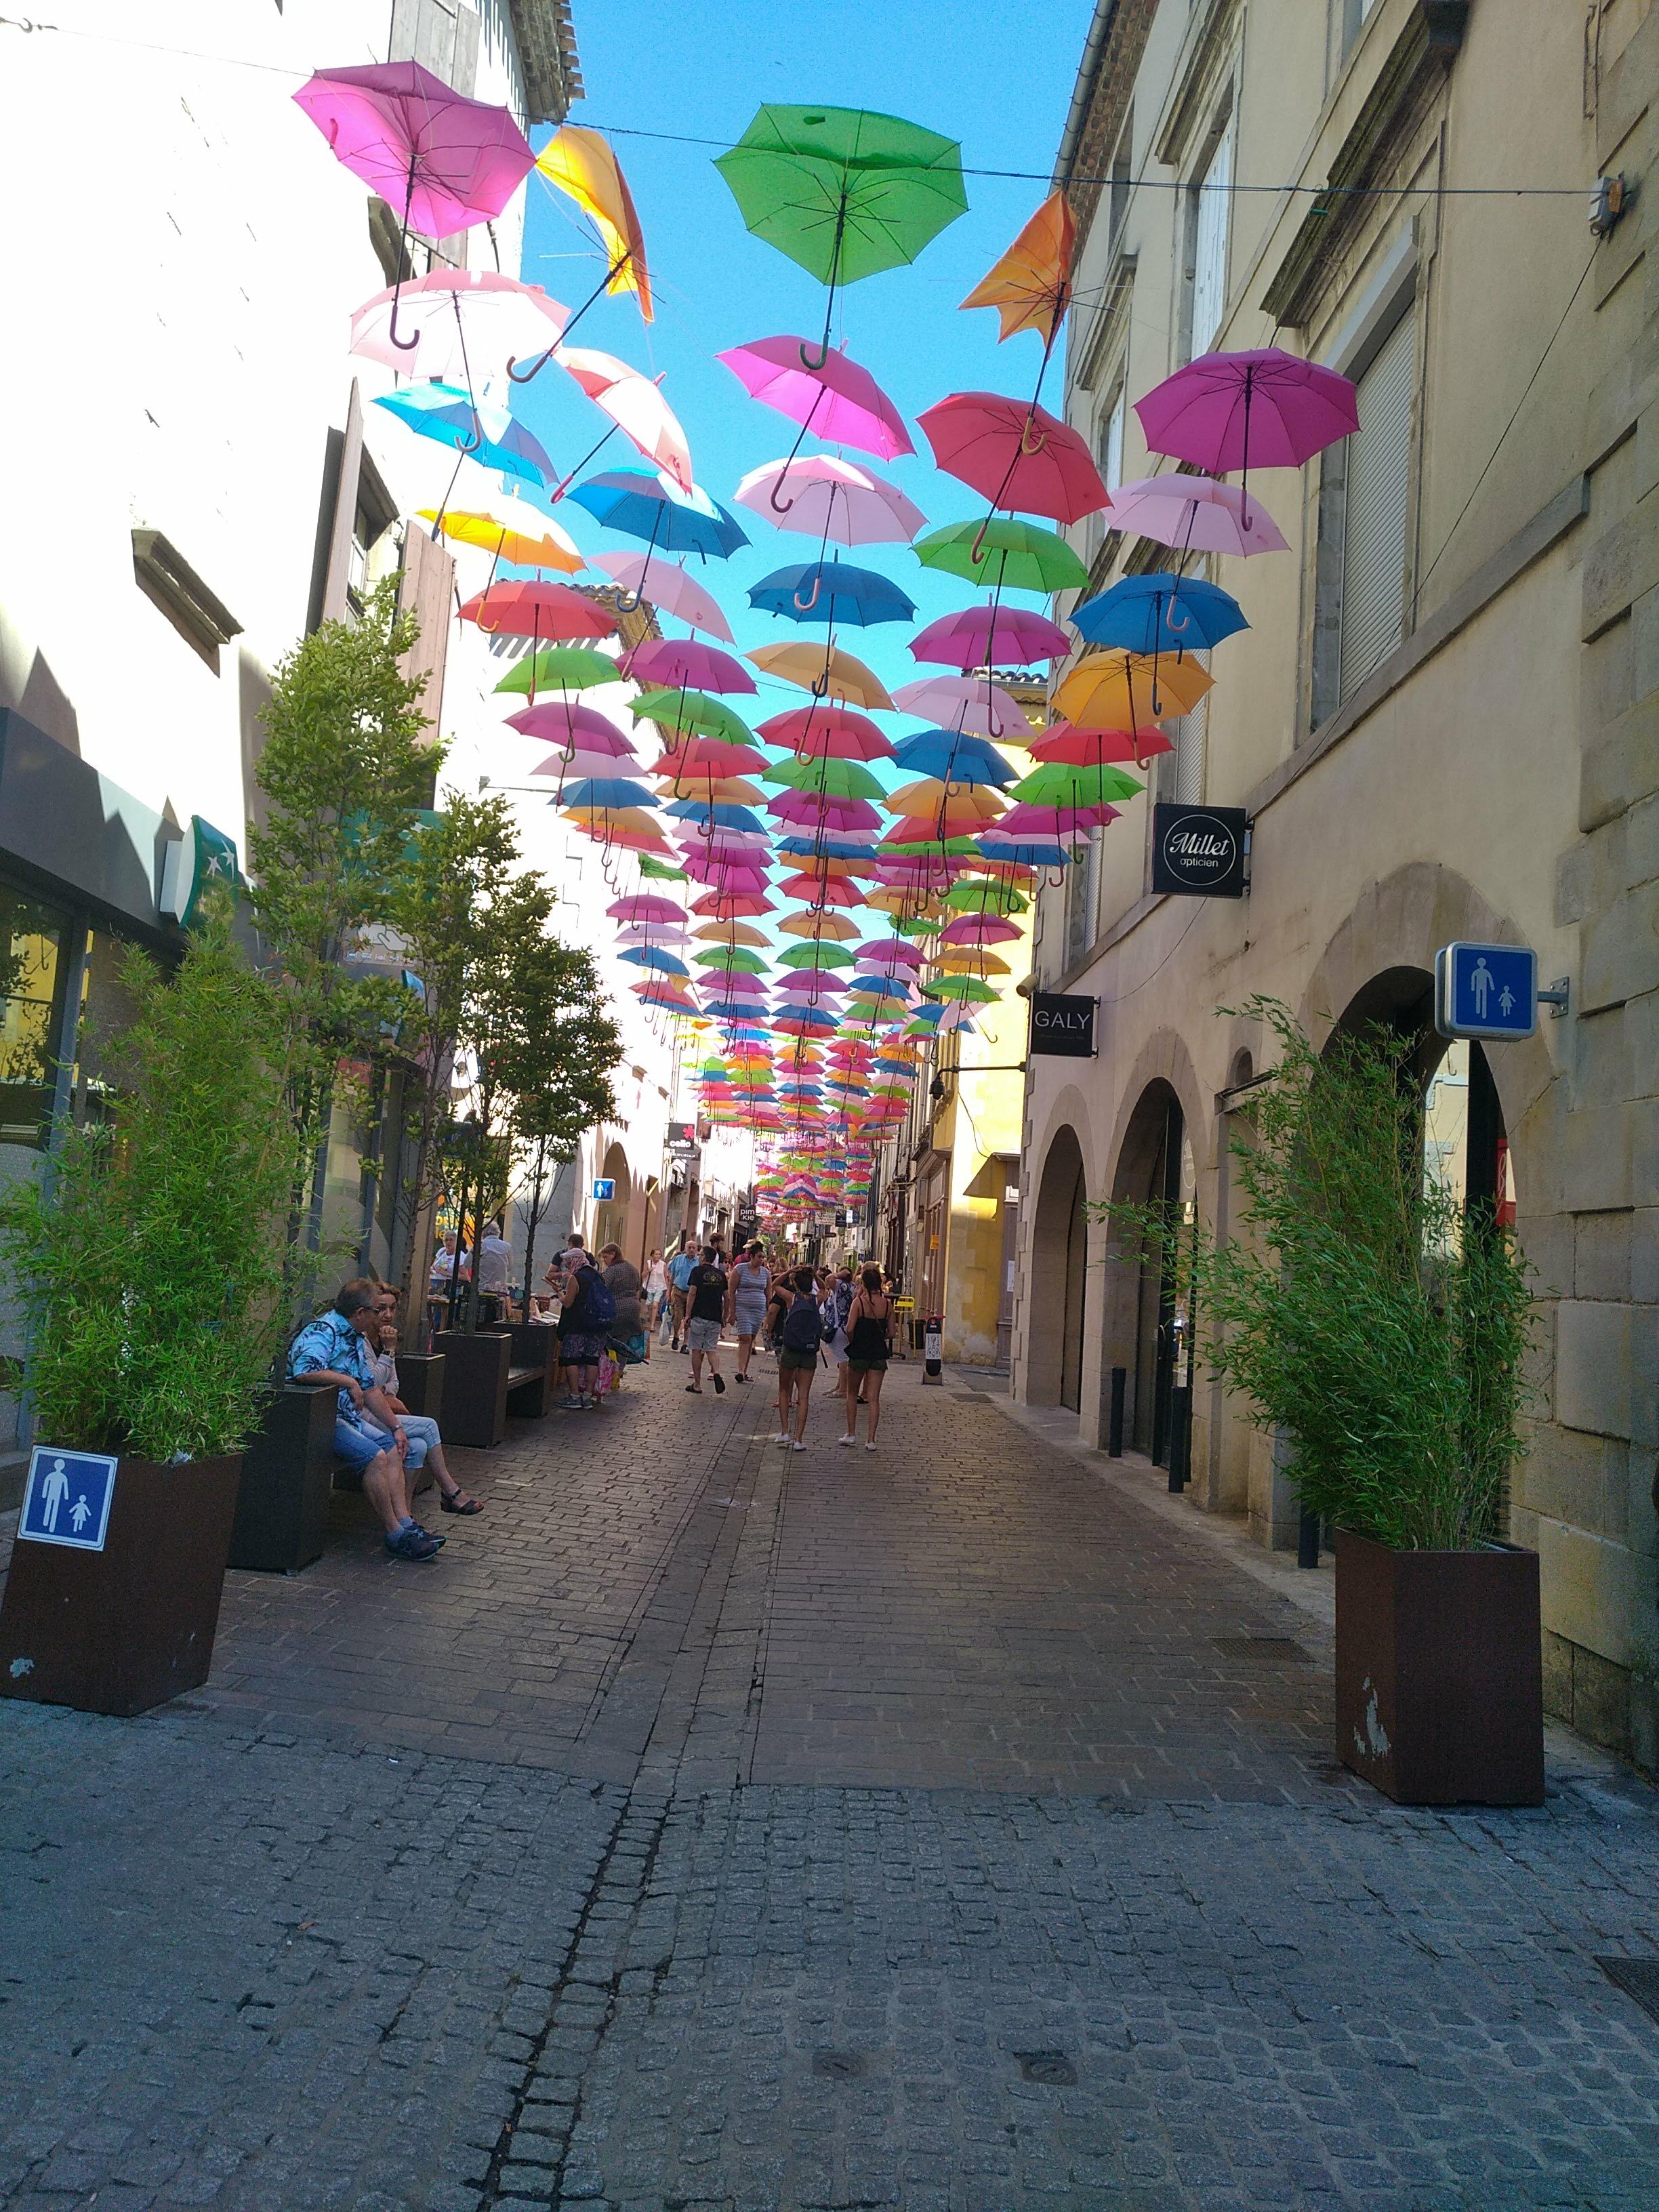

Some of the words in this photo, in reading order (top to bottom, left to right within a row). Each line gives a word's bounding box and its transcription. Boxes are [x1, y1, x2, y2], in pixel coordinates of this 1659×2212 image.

[1169, 832, 1230, 856] Millet
[1180, 857, 1218, 867] opticien
[1034, 1010, 1090, 1029] GALY
